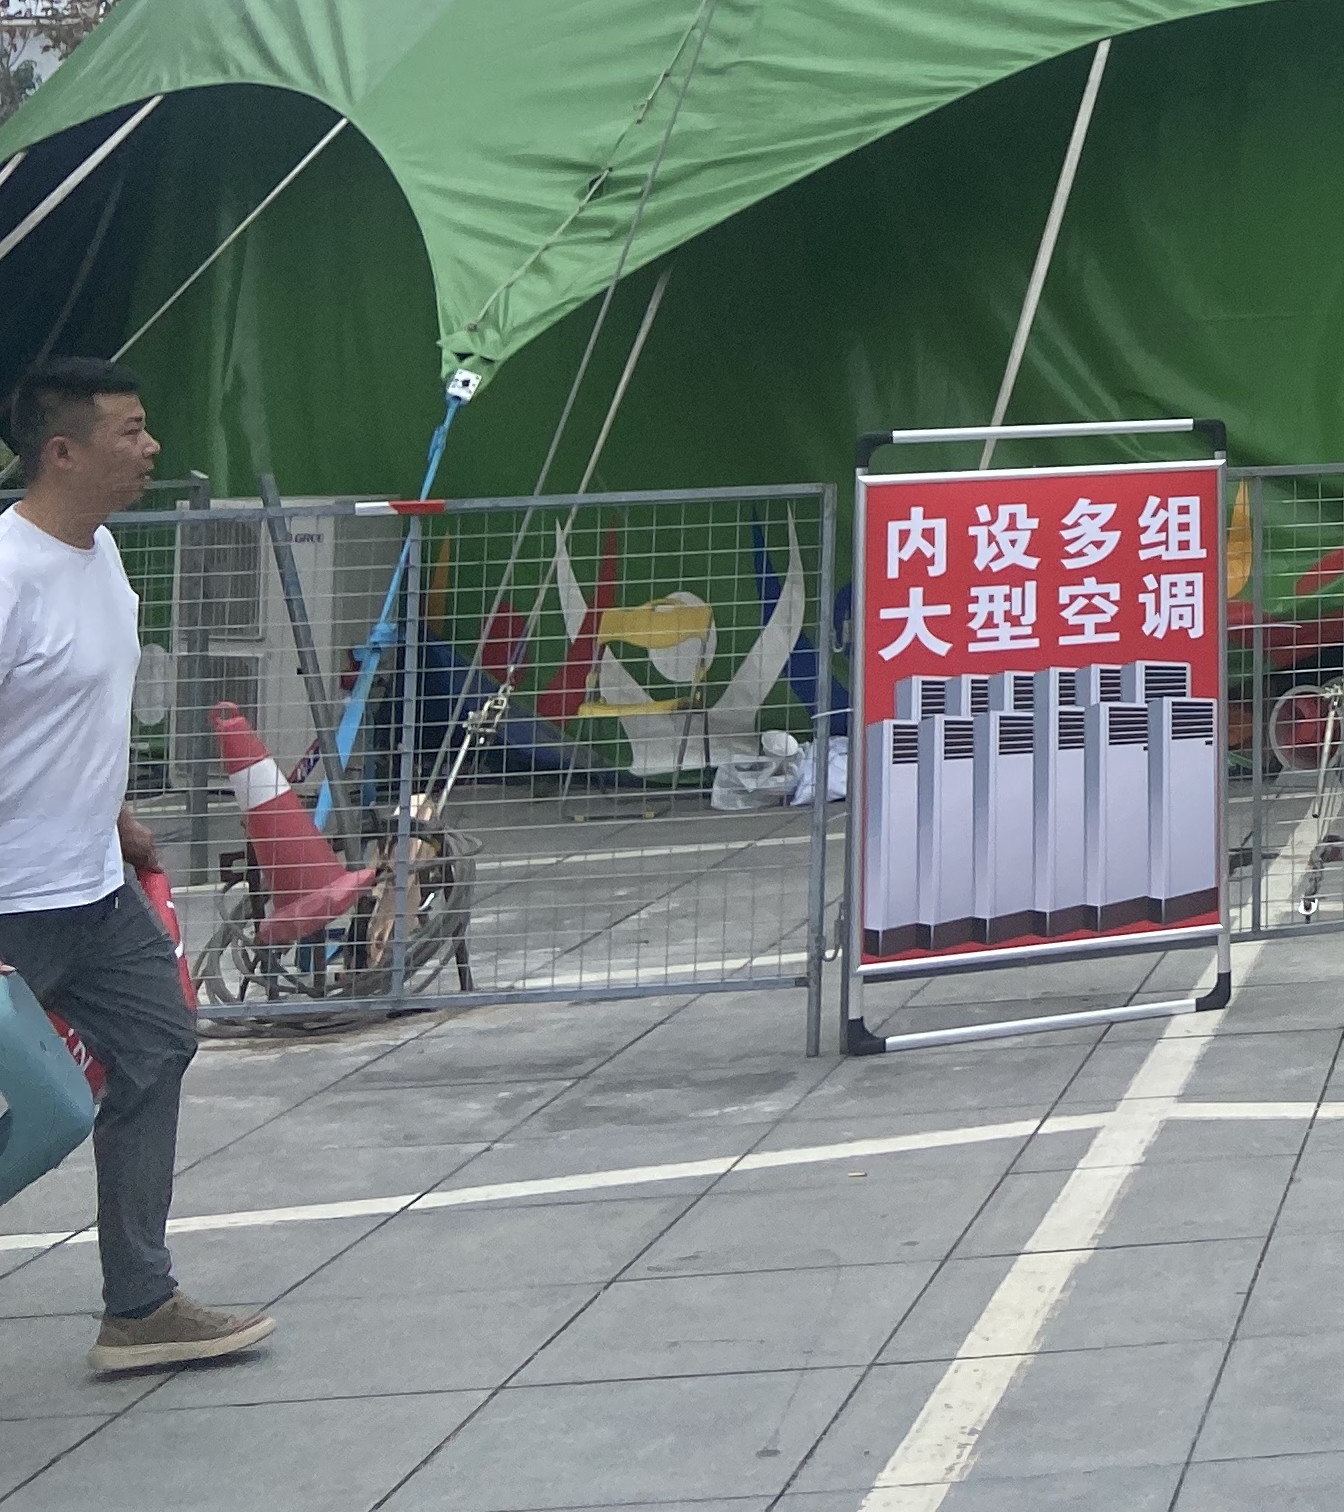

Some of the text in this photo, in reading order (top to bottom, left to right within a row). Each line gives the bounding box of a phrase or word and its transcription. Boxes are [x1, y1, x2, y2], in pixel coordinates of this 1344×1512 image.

[887, 495, 1208, 579] 内设多组
[877, 571, 1204, 661] 大型空调
